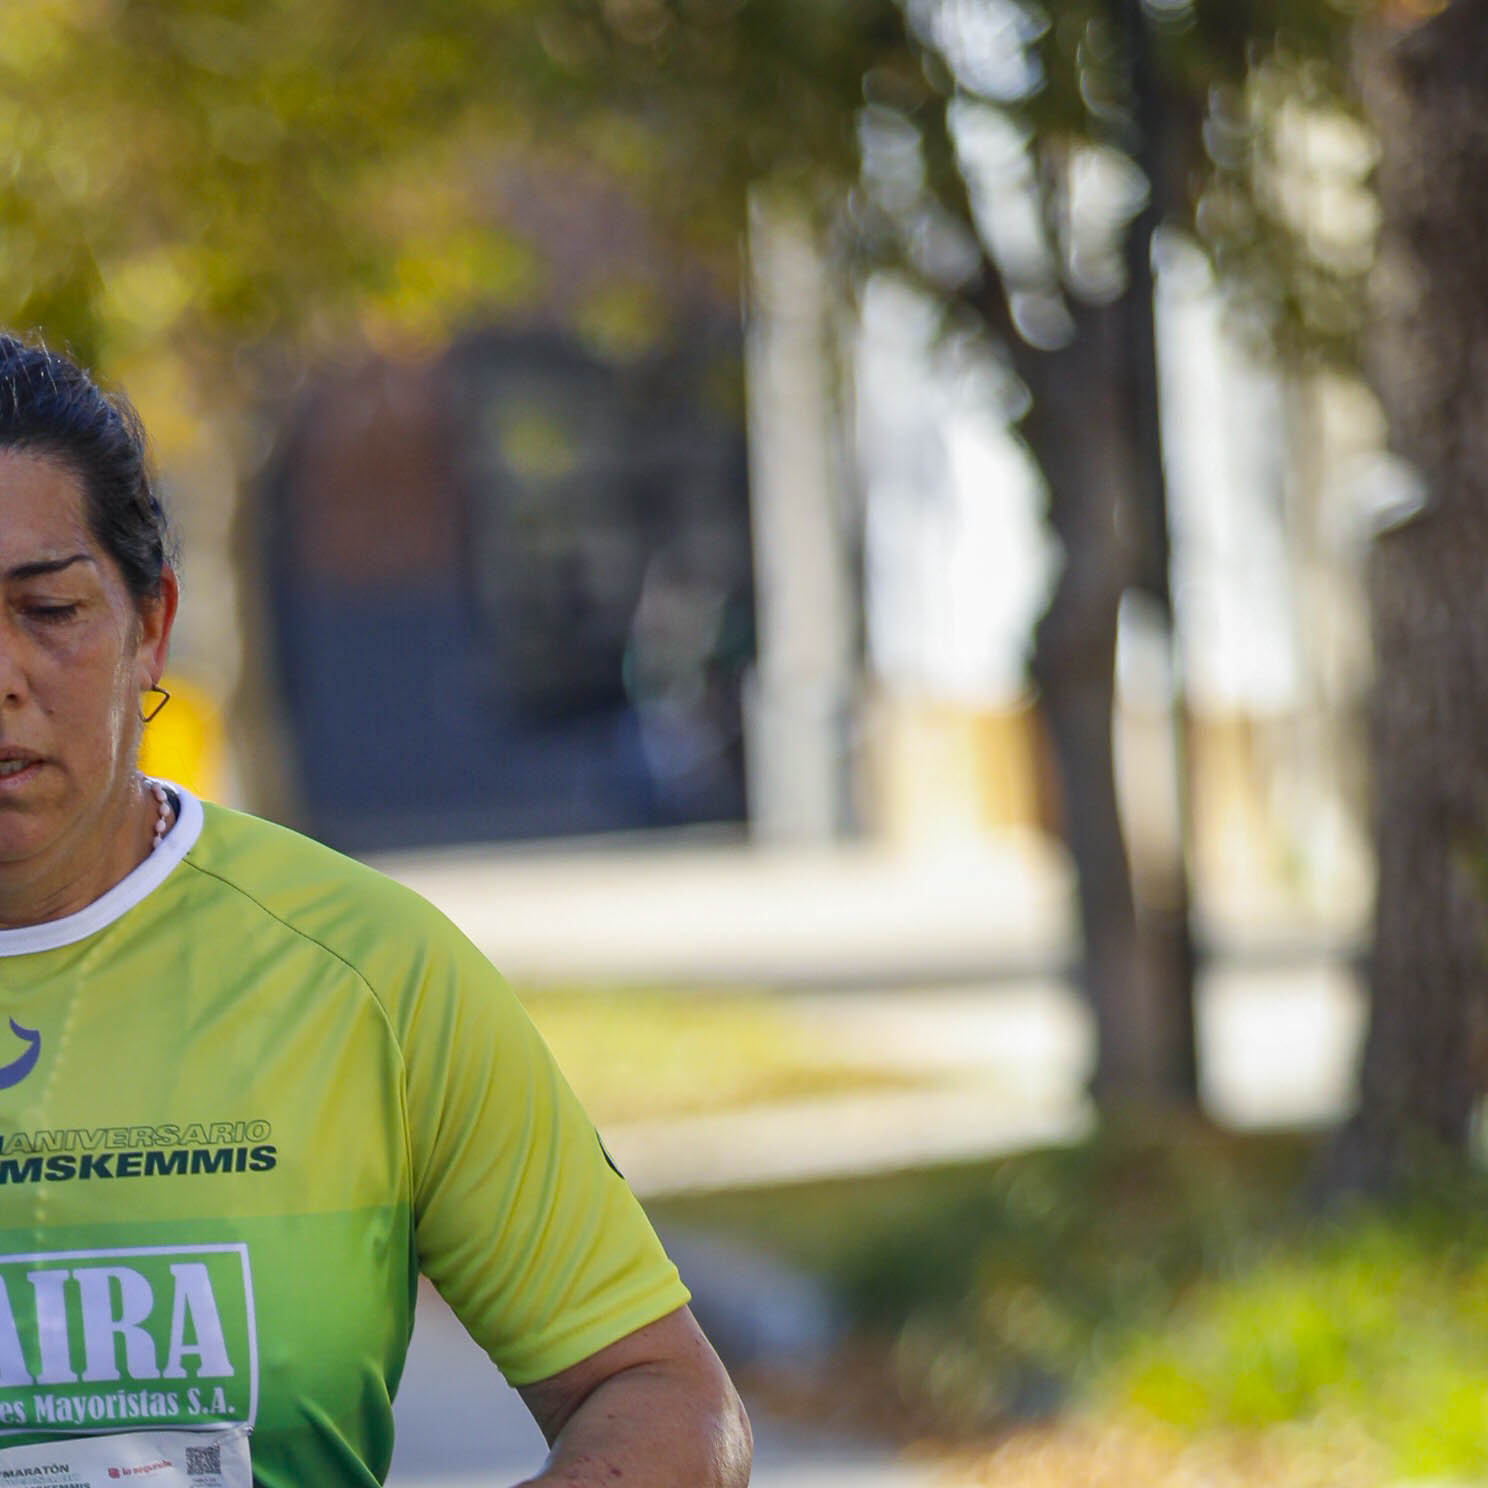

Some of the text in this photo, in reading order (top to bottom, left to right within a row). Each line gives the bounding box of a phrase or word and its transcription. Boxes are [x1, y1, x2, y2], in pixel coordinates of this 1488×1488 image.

[3, 1120, 272, 1155] ANIVERSARIO
[33, 1389, 179, 1425] Mayoristas
[186, 1387, 236, 1416] S.A.
